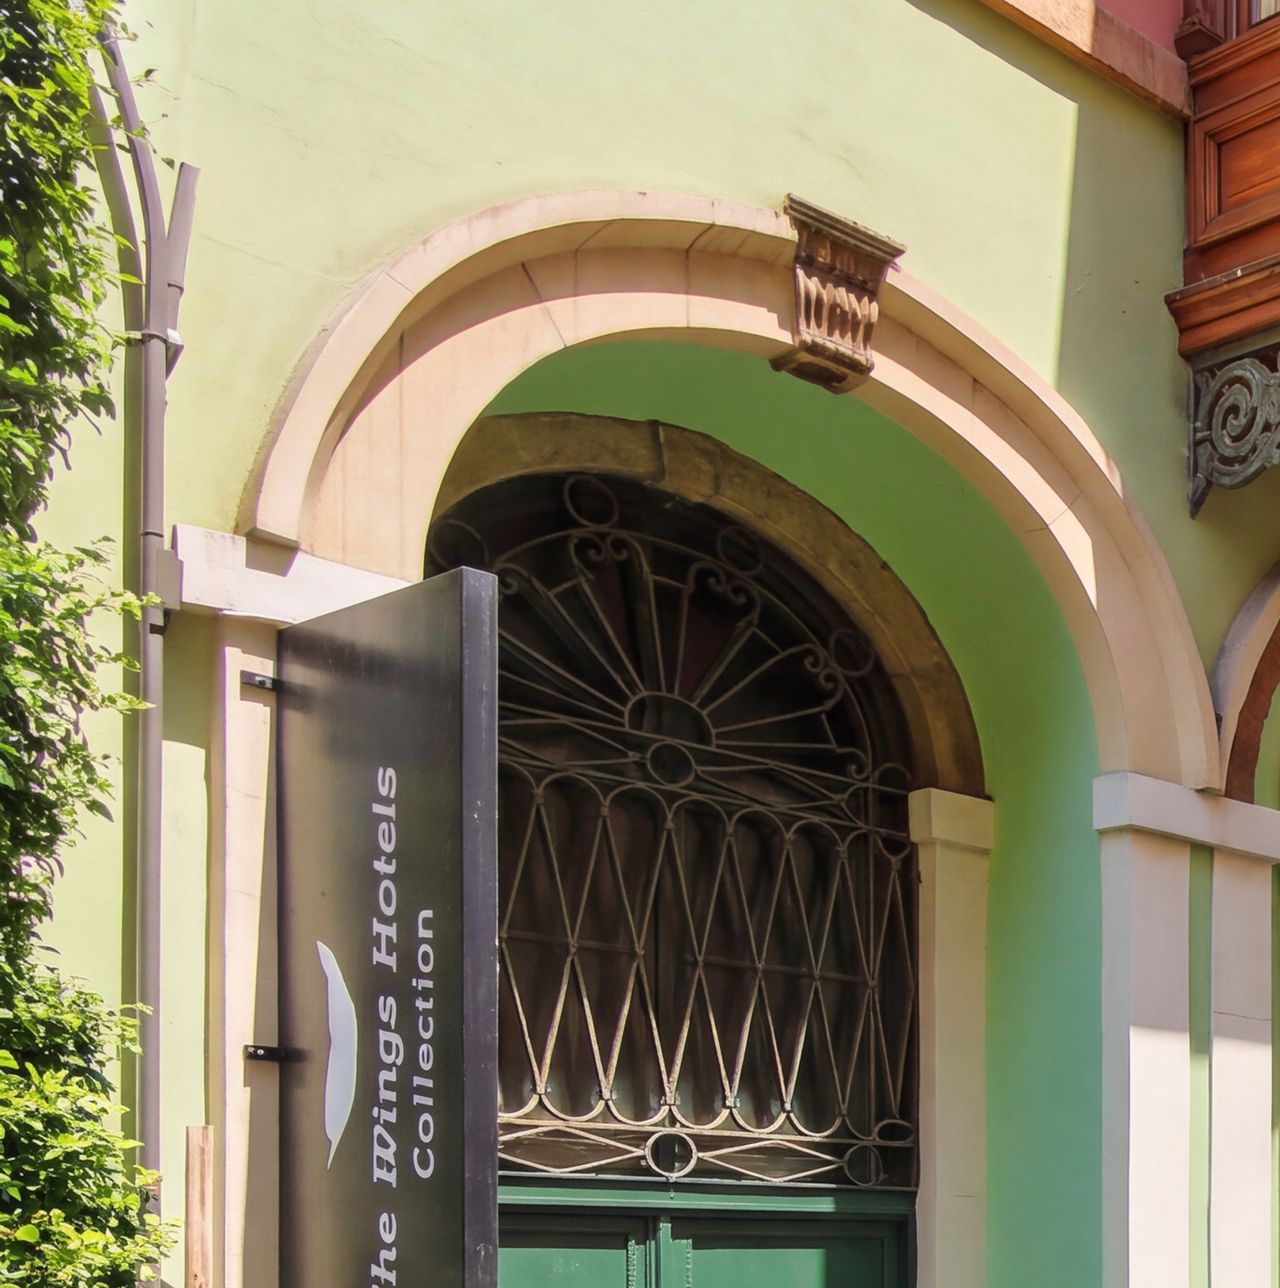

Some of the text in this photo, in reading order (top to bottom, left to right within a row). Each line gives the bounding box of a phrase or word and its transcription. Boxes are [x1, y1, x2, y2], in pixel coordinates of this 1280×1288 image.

[371, 766, 398, 974] Hotels
[372, 995, 405, 1188] Wings
[411, 908, 436, 1180] Collection
